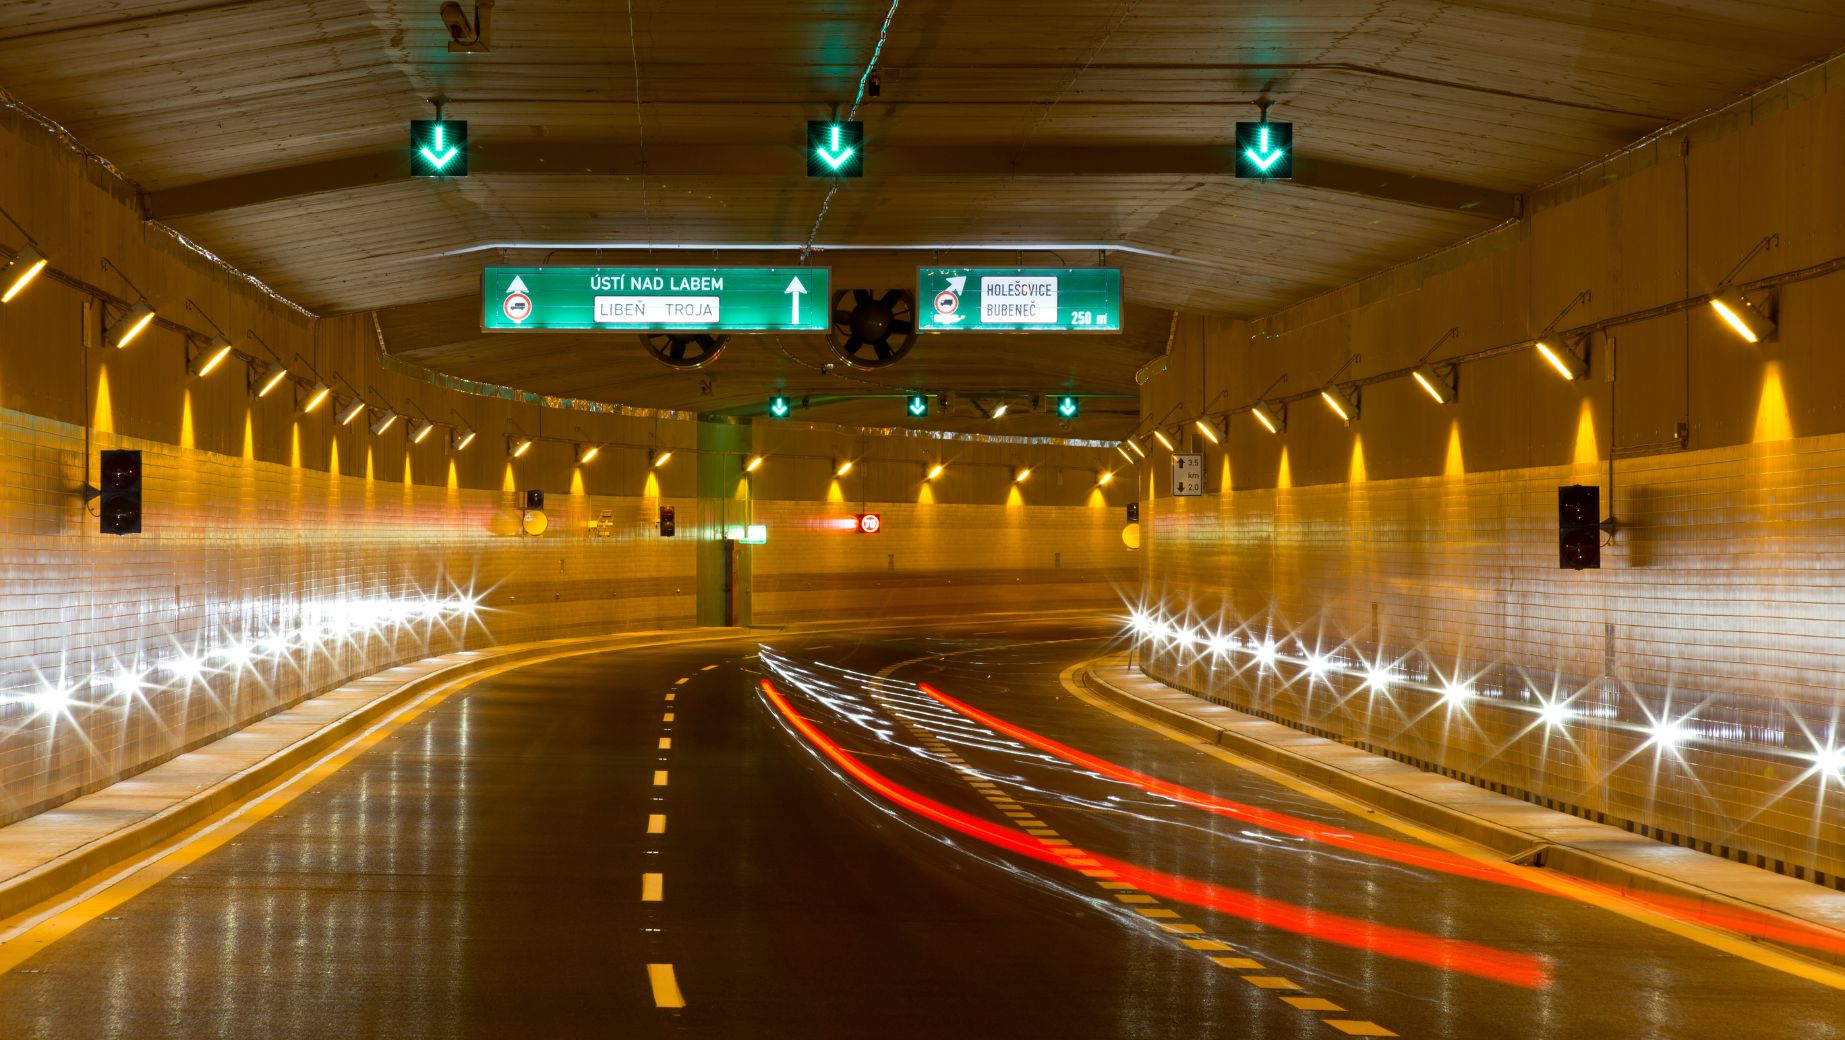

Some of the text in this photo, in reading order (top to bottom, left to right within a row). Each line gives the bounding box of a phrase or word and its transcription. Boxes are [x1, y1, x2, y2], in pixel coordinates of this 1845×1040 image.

[591, 274, 723, 290] ÚSTÍ NAD LABEM
[600, 300, 713, 316] LIBEŇ TROJA
[987, 300, 1036, 317] BUBENEČ
[1071, 311, 1108, 325] 250 m
[864, 518, 877, 530] 70
